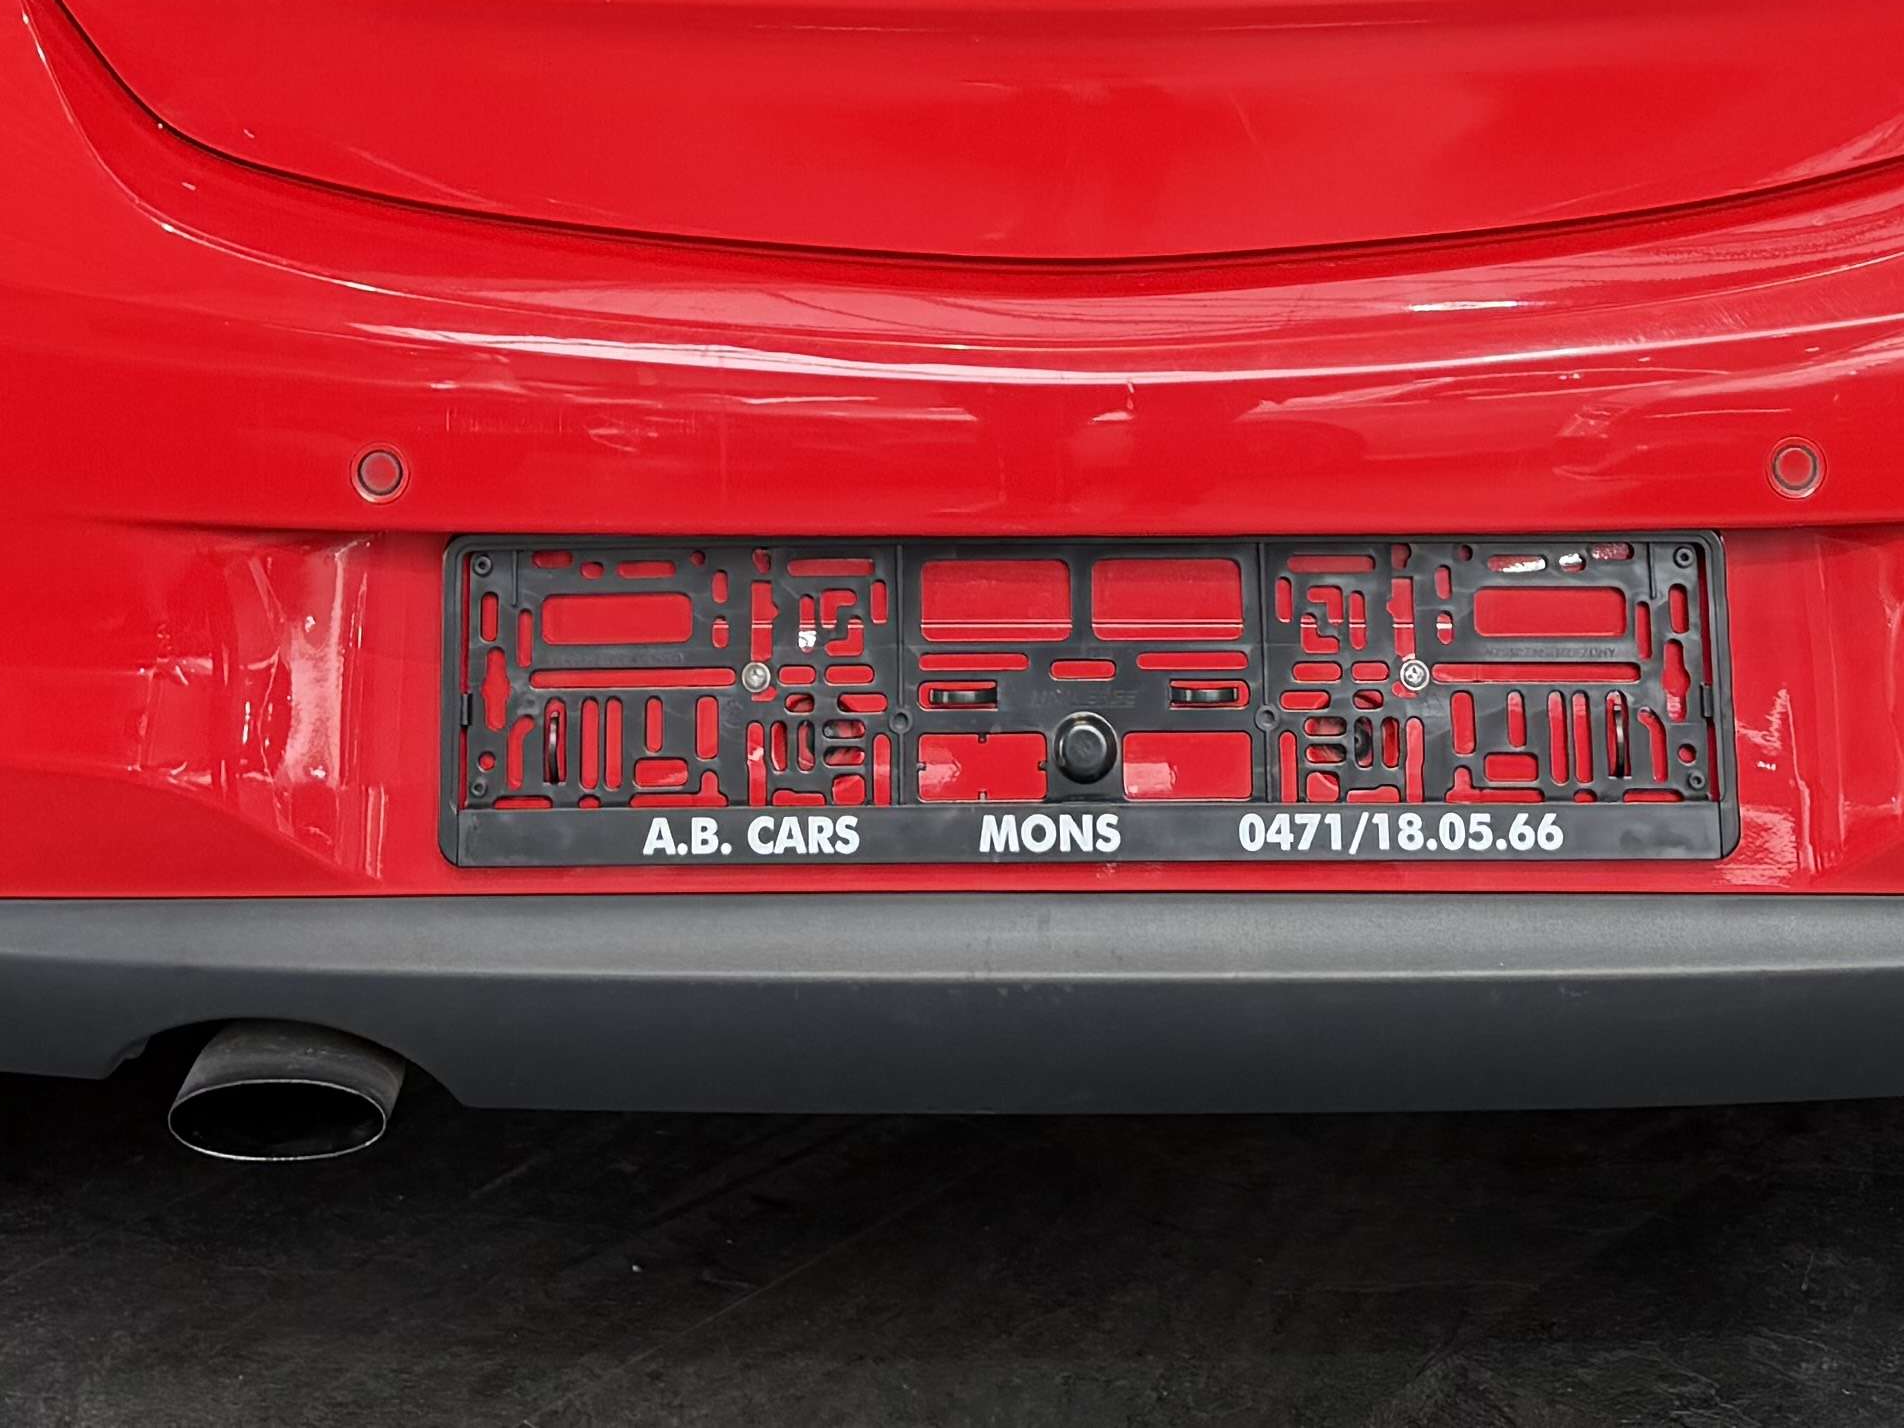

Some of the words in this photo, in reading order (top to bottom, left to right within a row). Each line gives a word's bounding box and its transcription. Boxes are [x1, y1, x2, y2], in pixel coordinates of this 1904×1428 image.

[642, 816, 732, 856] A.B.
[746, 815, 861, 856] CARS
[978, 813, 1122, 854] MONS
[1237, 812, 1565, 856] 0471/18.05.66
